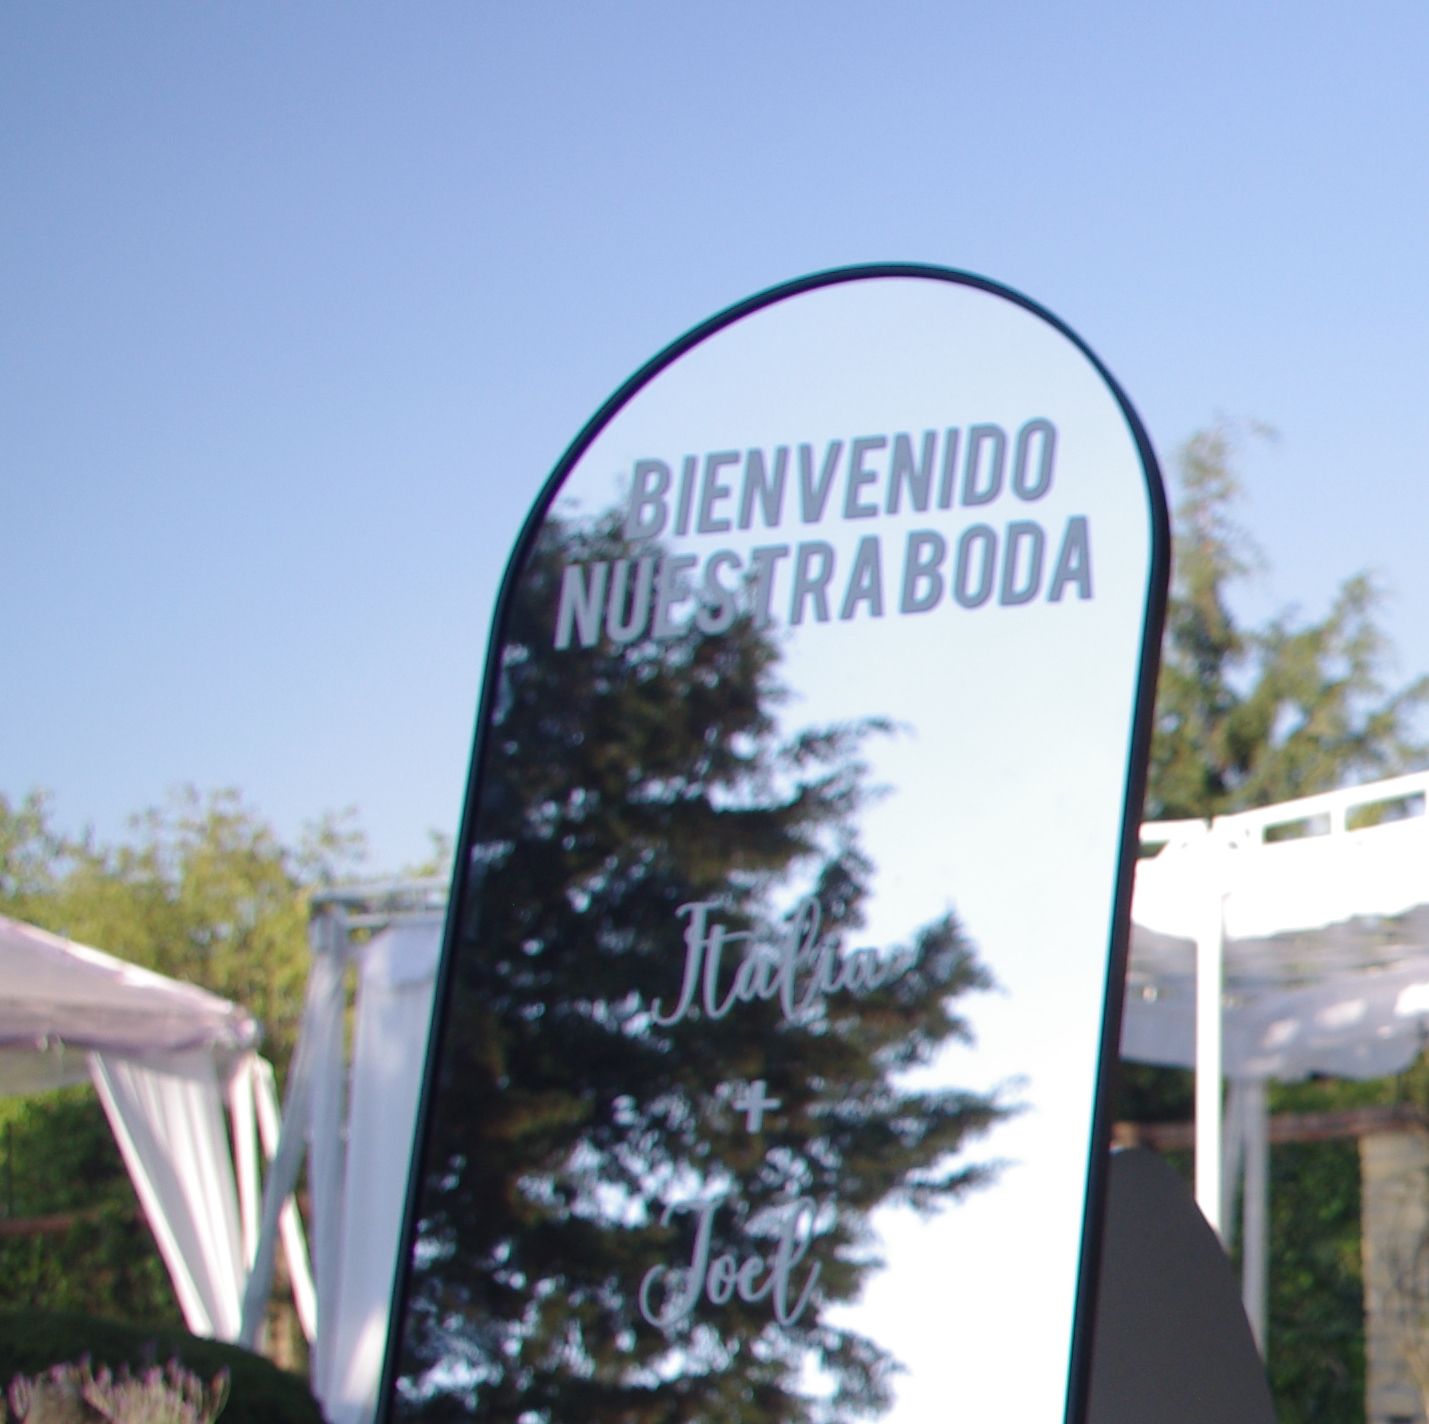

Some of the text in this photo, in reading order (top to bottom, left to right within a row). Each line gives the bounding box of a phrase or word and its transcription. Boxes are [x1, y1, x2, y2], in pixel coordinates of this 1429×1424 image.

[624, 417, 1057, 542] BIENVENIDO
[554, 515, 1094, 650] NUESTRA BODA
[651, 899, 886, 1026] Italia
[735, 1080, 780, 1132] +
[640, 1197, 820, 1327] Joel
